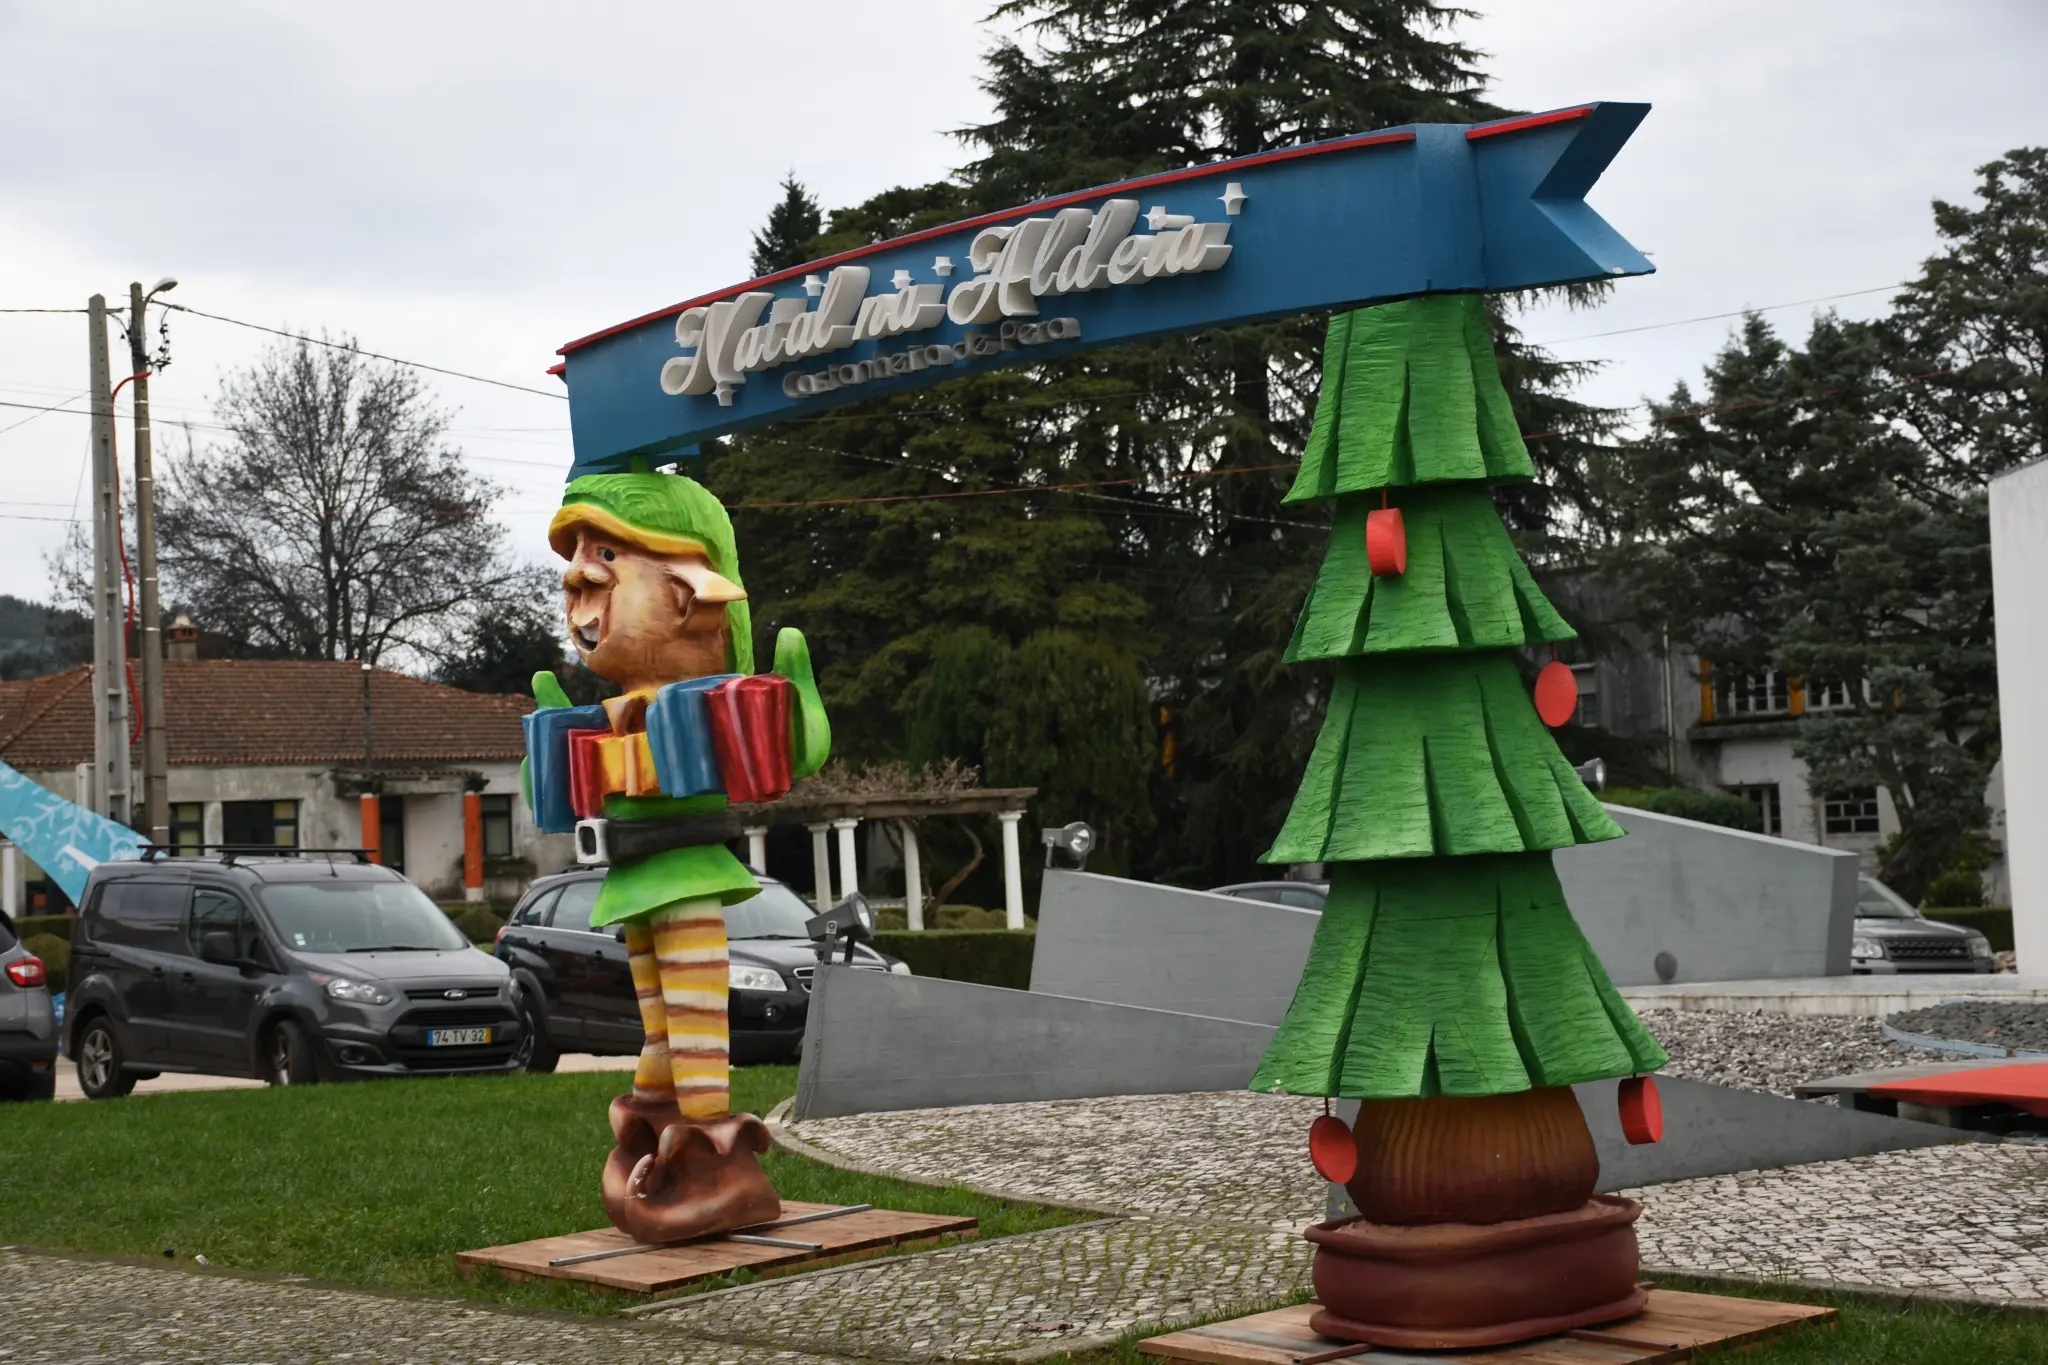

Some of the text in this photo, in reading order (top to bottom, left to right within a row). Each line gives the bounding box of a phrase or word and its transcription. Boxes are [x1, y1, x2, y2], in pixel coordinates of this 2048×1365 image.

[660, 199, 1233, 396] Natal na Aldeia
[952, 331, 1002, 360] de
[434, 1029, 485, 1044] 74 TV 32
